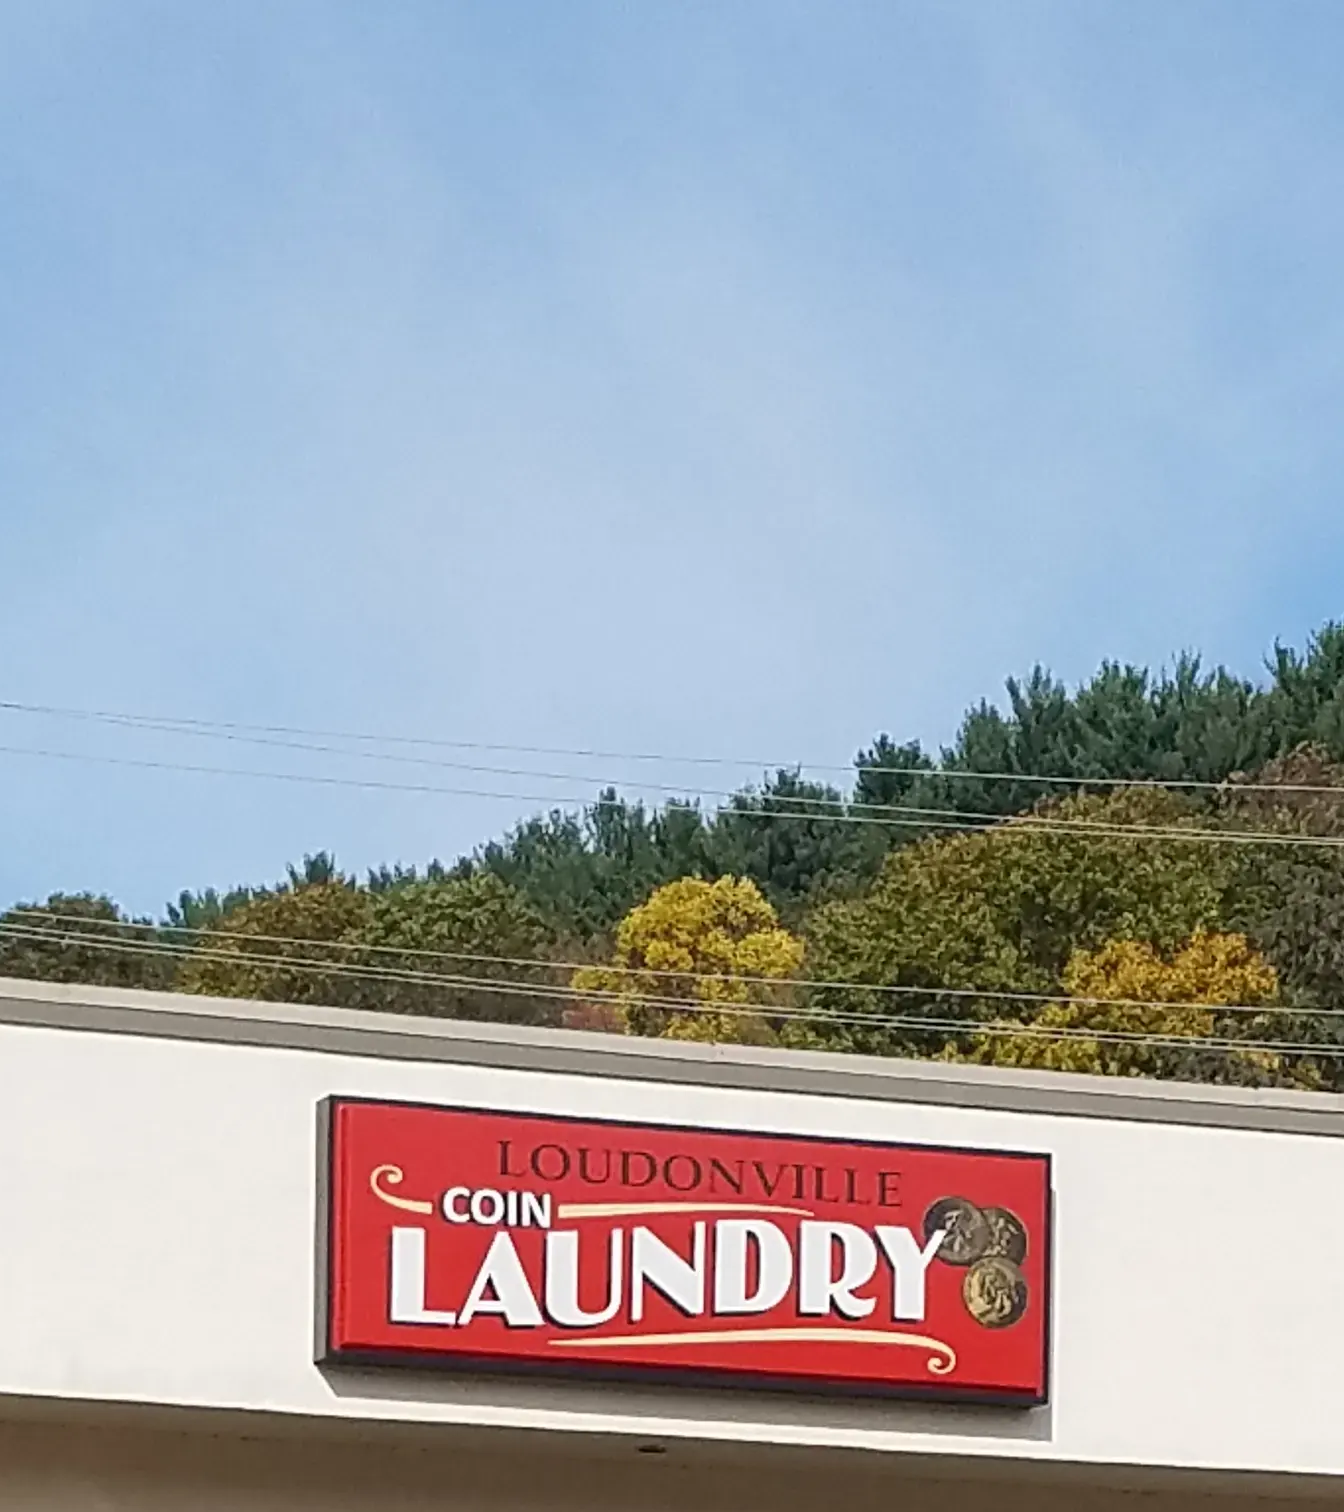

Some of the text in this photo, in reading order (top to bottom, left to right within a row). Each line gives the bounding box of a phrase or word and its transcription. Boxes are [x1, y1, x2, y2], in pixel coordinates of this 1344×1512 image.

[496, 1140, 903, 1207] LOUDONVILLE
[441, 1187, 552, 1229] COIN
[389, 1218, 947, 1329] LAUNDRY
